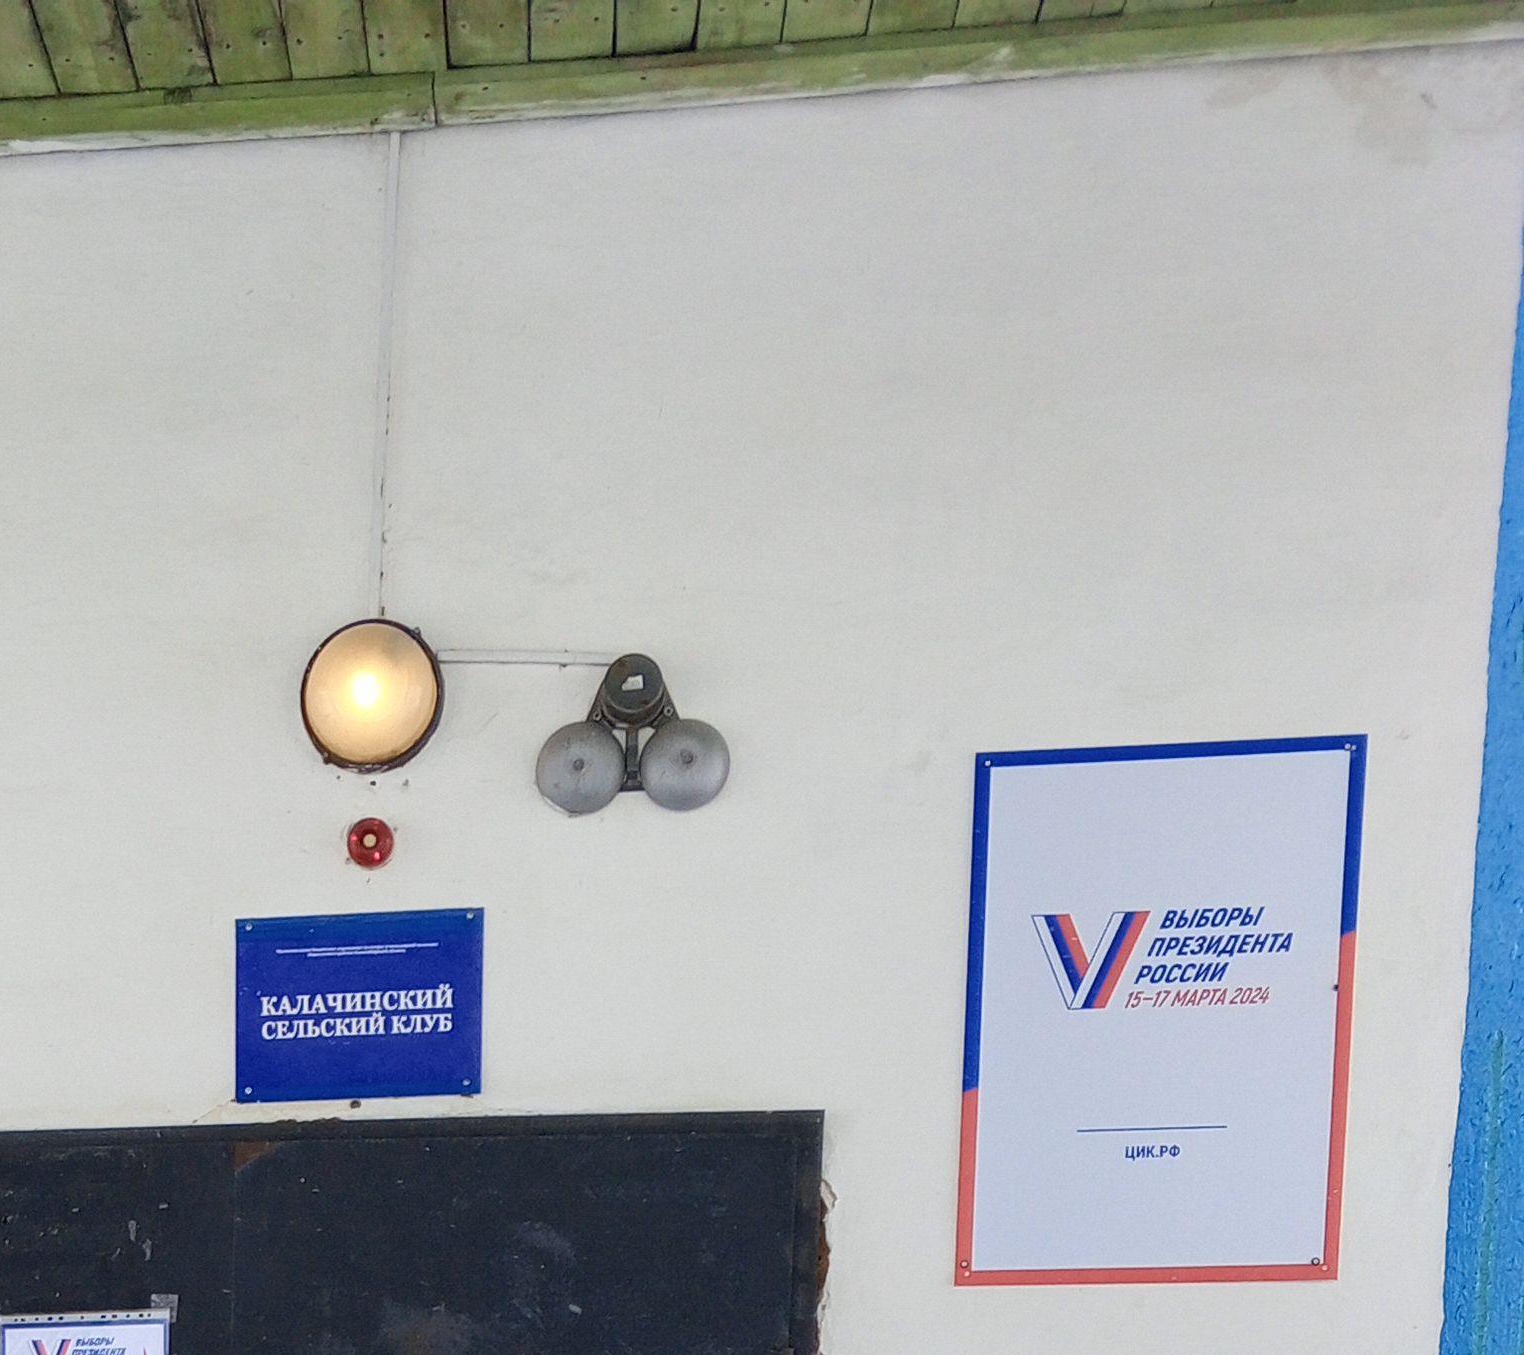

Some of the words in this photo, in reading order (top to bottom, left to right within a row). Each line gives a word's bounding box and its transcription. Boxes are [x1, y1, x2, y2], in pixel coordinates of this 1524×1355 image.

[1159, 906, 1266, 931] ВЫБОРЫ
[1147, 932, 1295, 959] ПРЕЗИДЕНТА
[1133, 962, 1231, 986] РОССИИ
[260, 983, 454, 1017] КАЛАЧИНСКИЙ
[1170, 988, 1228, 1008] МАРТА
[1229, 986, 1271, 1006] 2024
[261, 1012, 386, 1040] СЕЛЬСКИЙ
[390, 1012, 453, 1035] КЛУБ
[1125, 1144, 1181, 1161] ЦИК.РФ
[75, 1337, 116, 1347] ВЫБОРЫ
